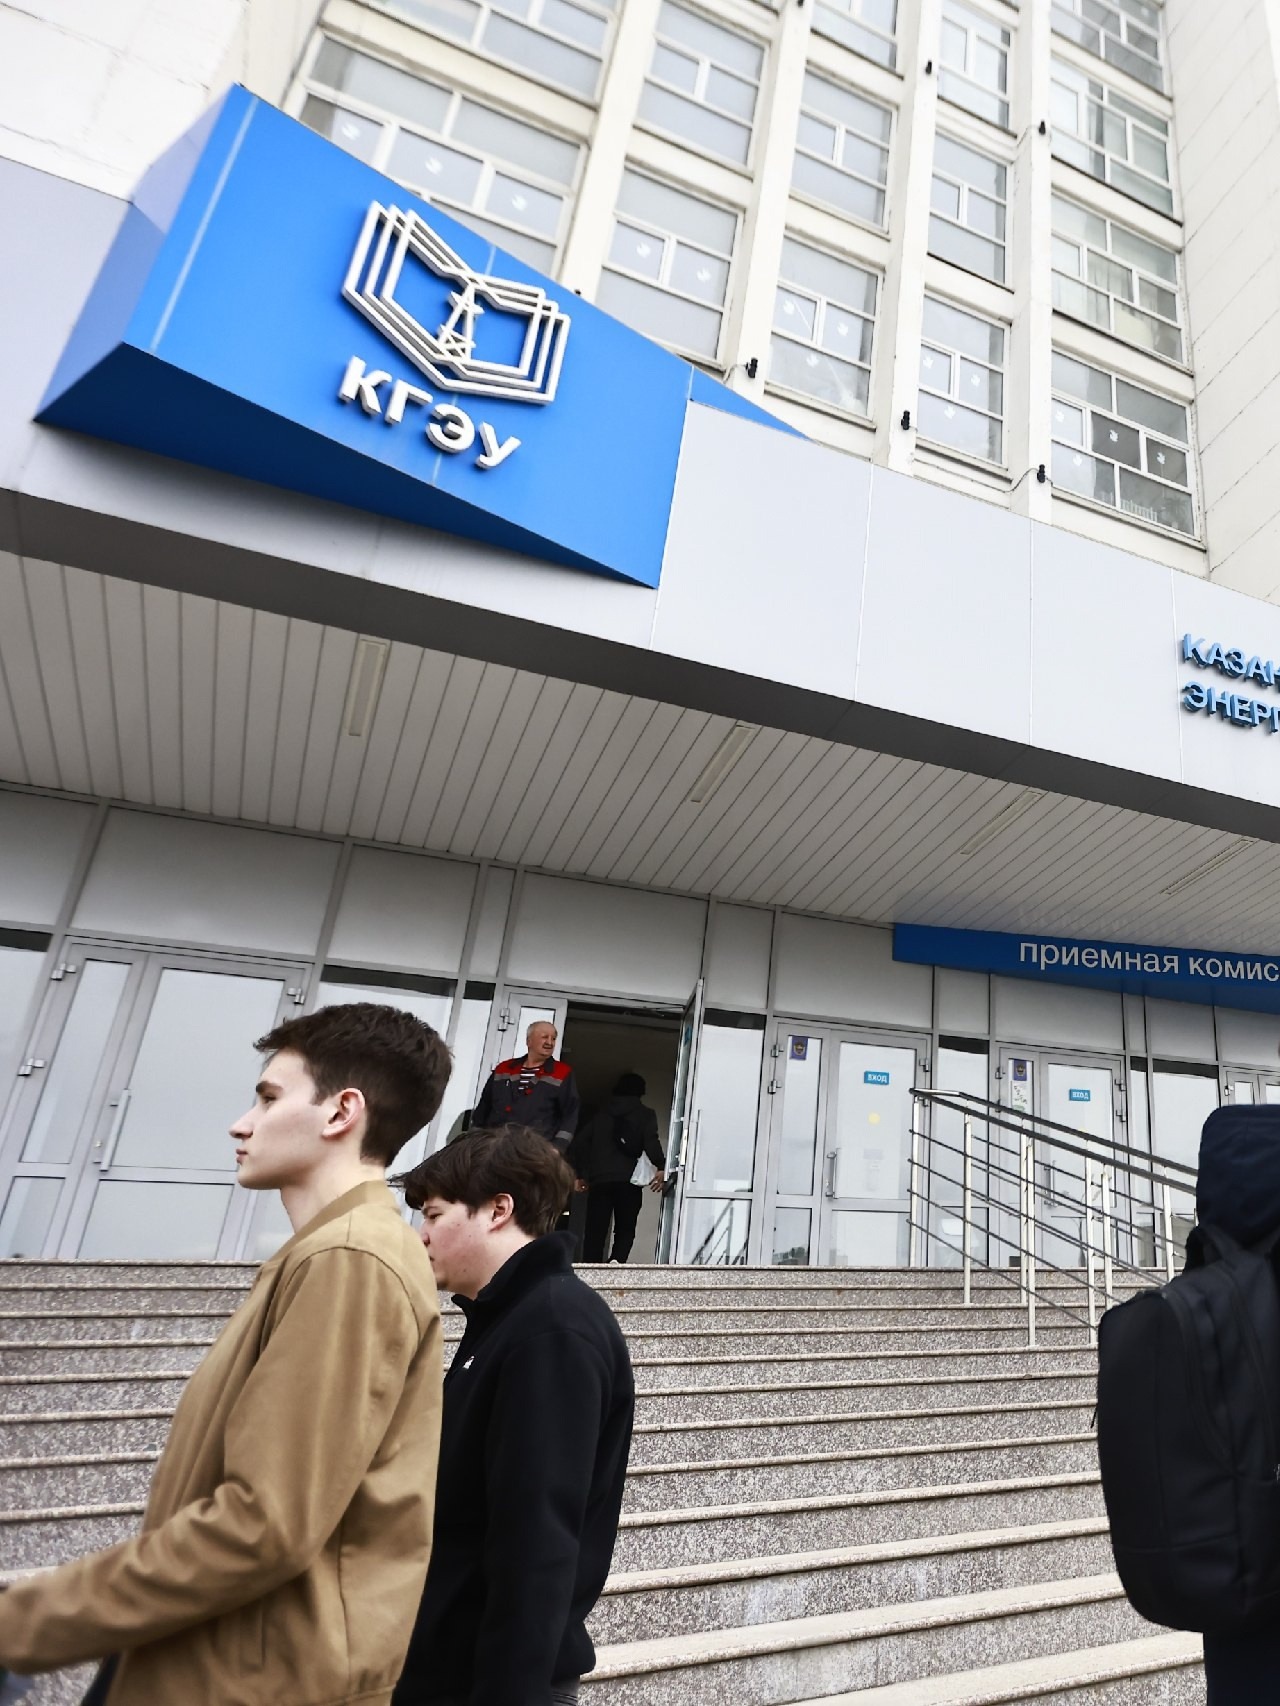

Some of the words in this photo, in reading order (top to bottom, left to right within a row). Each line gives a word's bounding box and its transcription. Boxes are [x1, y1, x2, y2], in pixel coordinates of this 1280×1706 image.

[338, 355, 522, 469] КГЭУ
[1020, 942, 1180, 974] приемная
[867, 1073, 888, 1084] ВХОД
